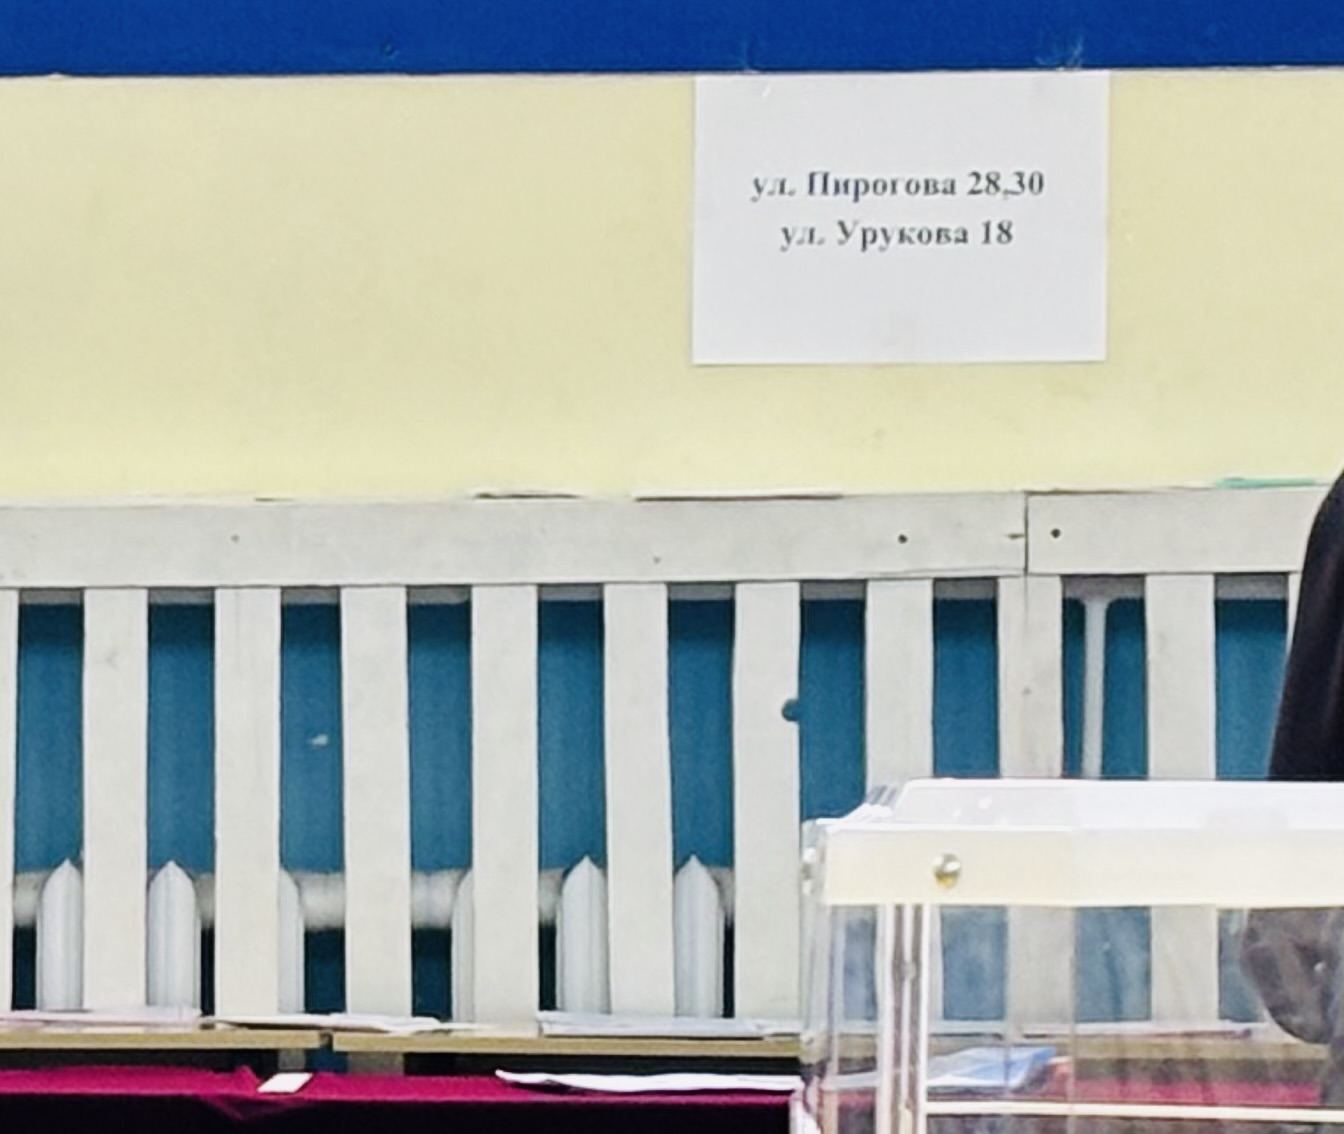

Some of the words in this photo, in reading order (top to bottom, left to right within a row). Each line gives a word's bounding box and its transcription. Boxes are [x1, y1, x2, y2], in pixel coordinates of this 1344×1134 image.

[750, 177, 795, 203] ул.
[807, 171, 957, 203] Пирогова
[780, 226, 825, 252] ул.
[836, 220, 968, 253] Урукова
[981, 219, 1014, 245] 18
